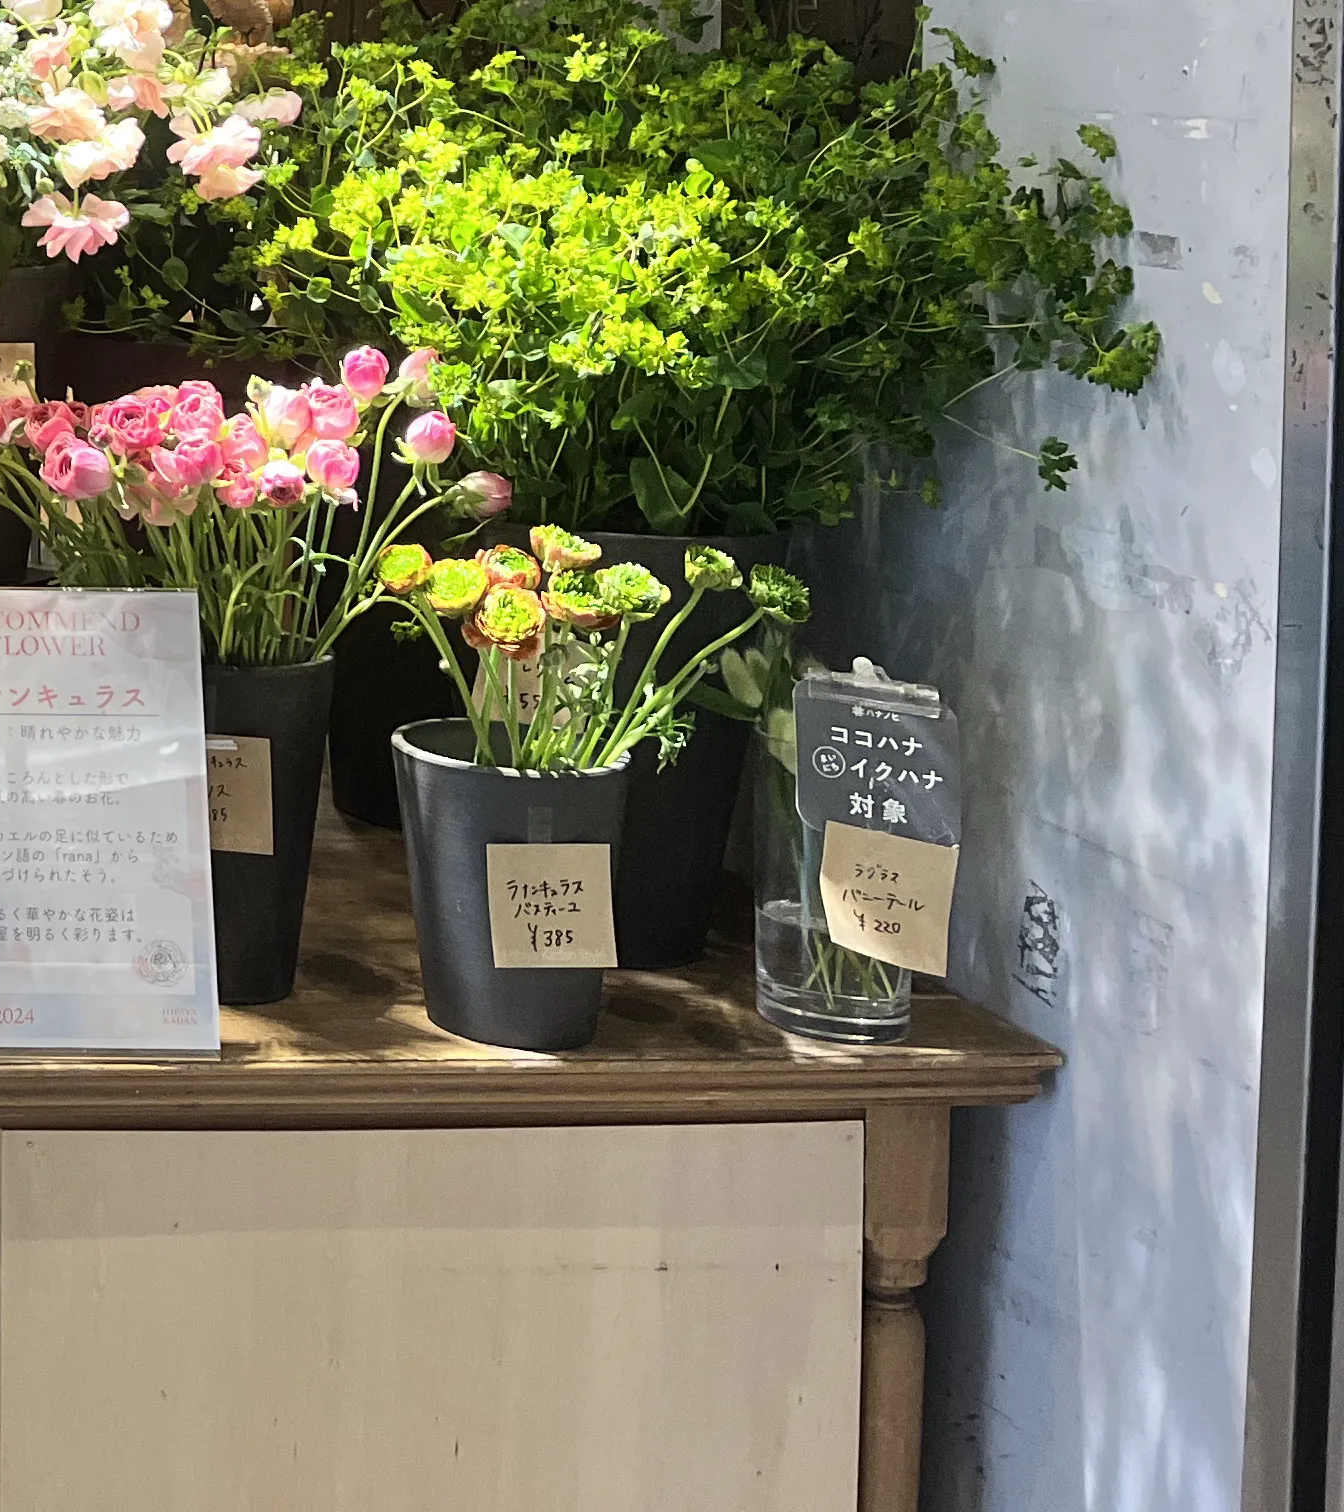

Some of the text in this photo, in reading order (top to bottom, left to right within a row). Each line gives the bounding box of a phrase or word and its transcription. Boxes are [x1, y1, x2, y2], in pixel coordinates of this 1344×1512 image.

[863, 708, 900, 723] ハナノヒ
[829, 725, 923, 757] ココハナ
[850, 758, 944, 790] イクハナ
[849, 791, 908, 824] 対象
[853, 862, 901, 885] ラグラス
[506, 879, 584, 901] ラナンキュラス
[842, 887, 926, 912] バニーテール
[514, 902, 581, 919] バスティーユ
[853, 909, 901, 935] ¥220
[527, 922, 574, 952] ¥385
